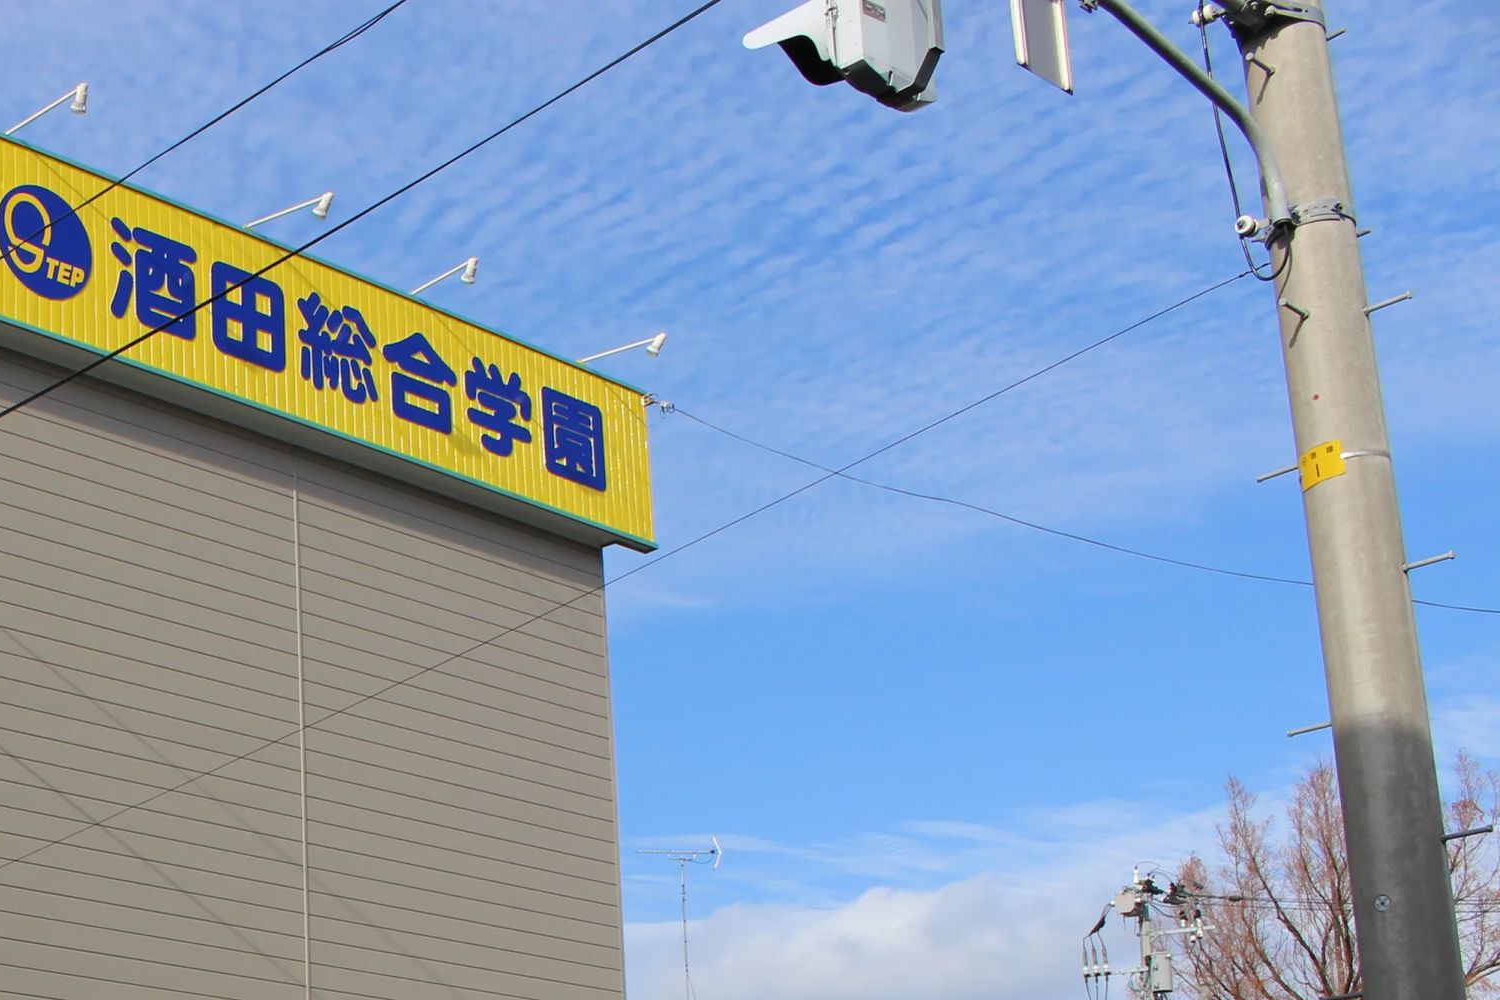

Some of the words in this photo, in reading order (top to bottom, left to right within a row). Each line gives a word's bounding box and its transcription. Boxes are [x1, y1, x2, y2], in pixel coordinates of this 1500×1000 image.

[111, 215, 607, 492] 酒田総合学園
